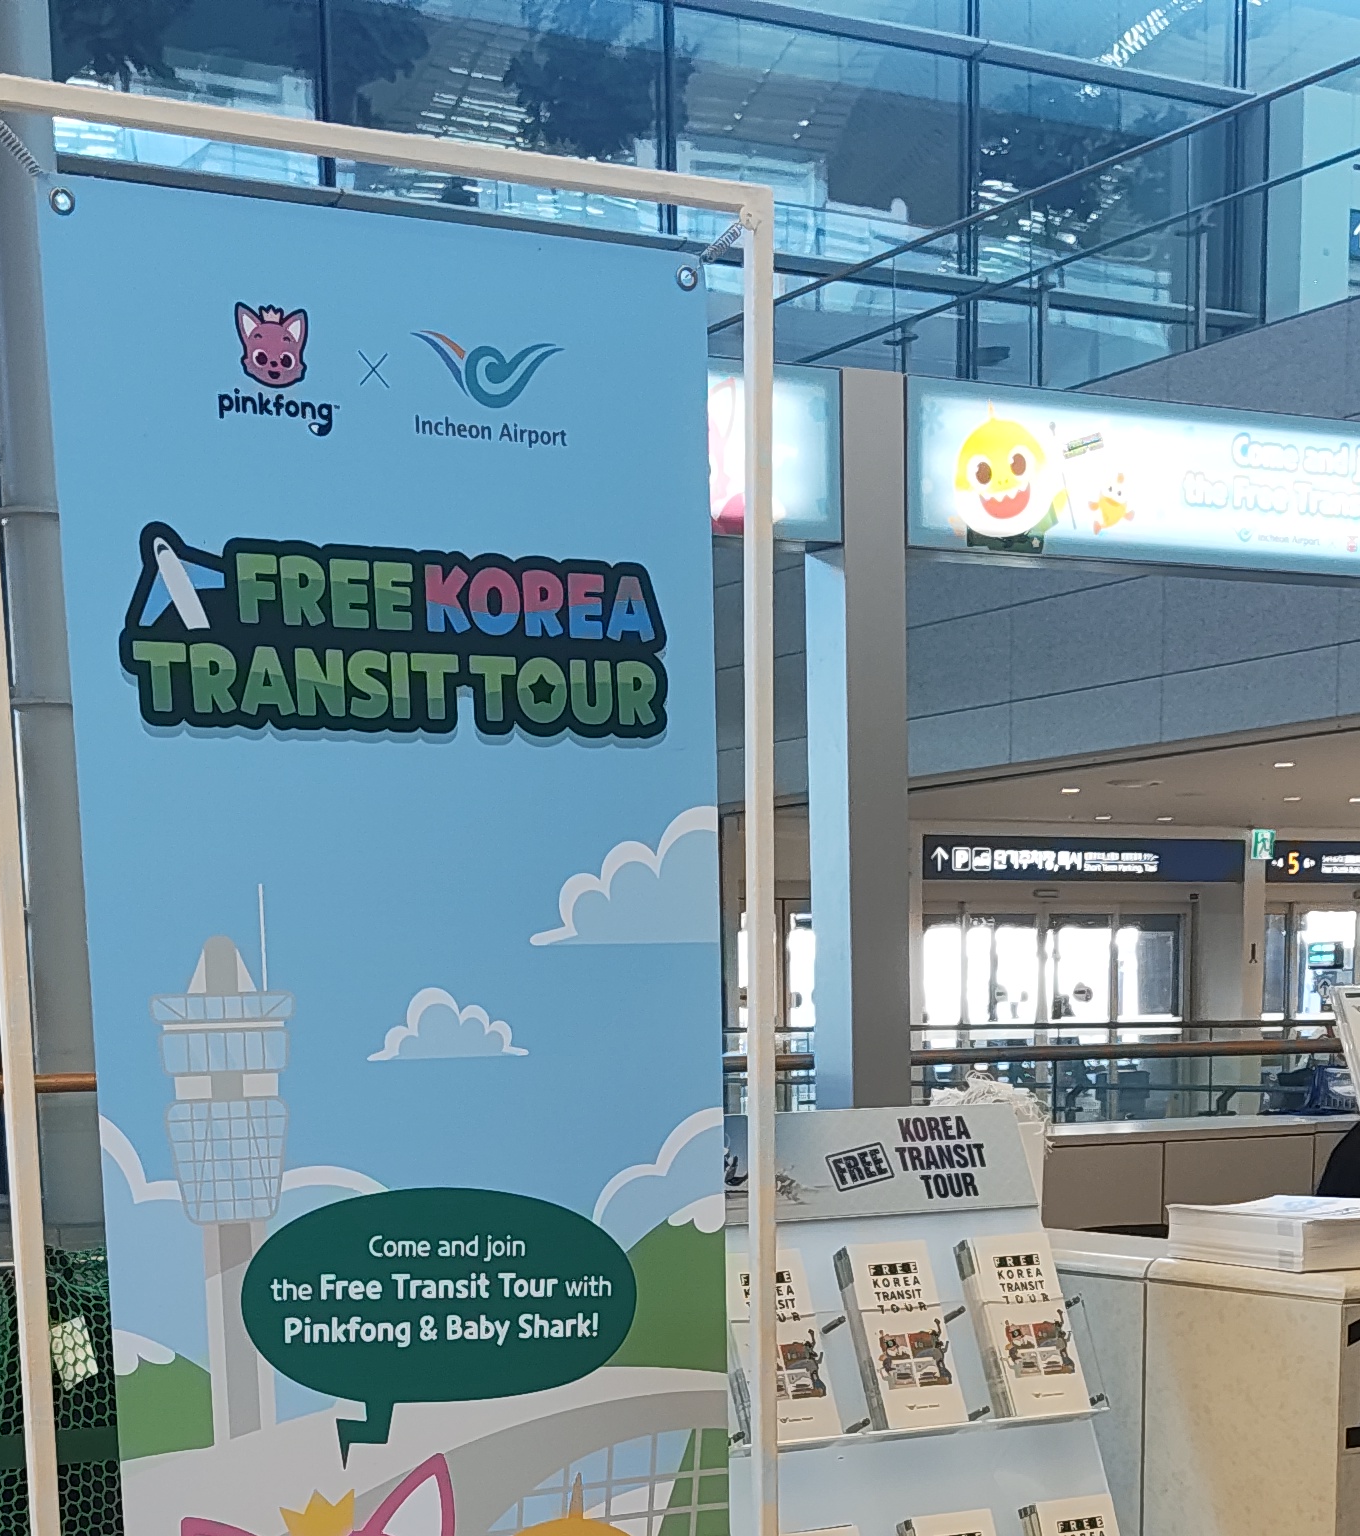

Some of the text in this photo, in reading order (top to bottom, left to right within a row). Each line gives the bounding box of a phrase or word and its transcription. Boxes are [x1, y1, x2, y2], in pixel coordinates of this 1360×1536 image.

[218, 390, 333, 436] pinkfong
[415, 415, 567, 447] Incheon Airport
[236, 553, 655, 641] FREE KOREA
[133, 641, 657, 726] TRANSIT TOUR
[1288, 852, 1299, 874] 5
[831, 1116, 971, 1186] FREE KOREA
[895, 1143, 986, 1172] TRANSIT
[920, 1173, 979, 1199] TOUR
[369, 1235, 525, 1262] Come and join
[994, 1253, 1040, 1267] FREE
[869, 1261, 918, 1275] FREE
[997, 1268, 1043, 1280] KOREA
[271, 1272, 612, 1301] the Free Transit Tour with
[872, 1276, 920, 1288] KOREA
[875, 1288, 922, 1301] TRANSIT
[999, 1280, 1045, 1293] TRANSIT
[285, 1313, 598, 1347] Pinkfong & Baby Shark!
[1057, 1516, 1104, 1533] FREE
